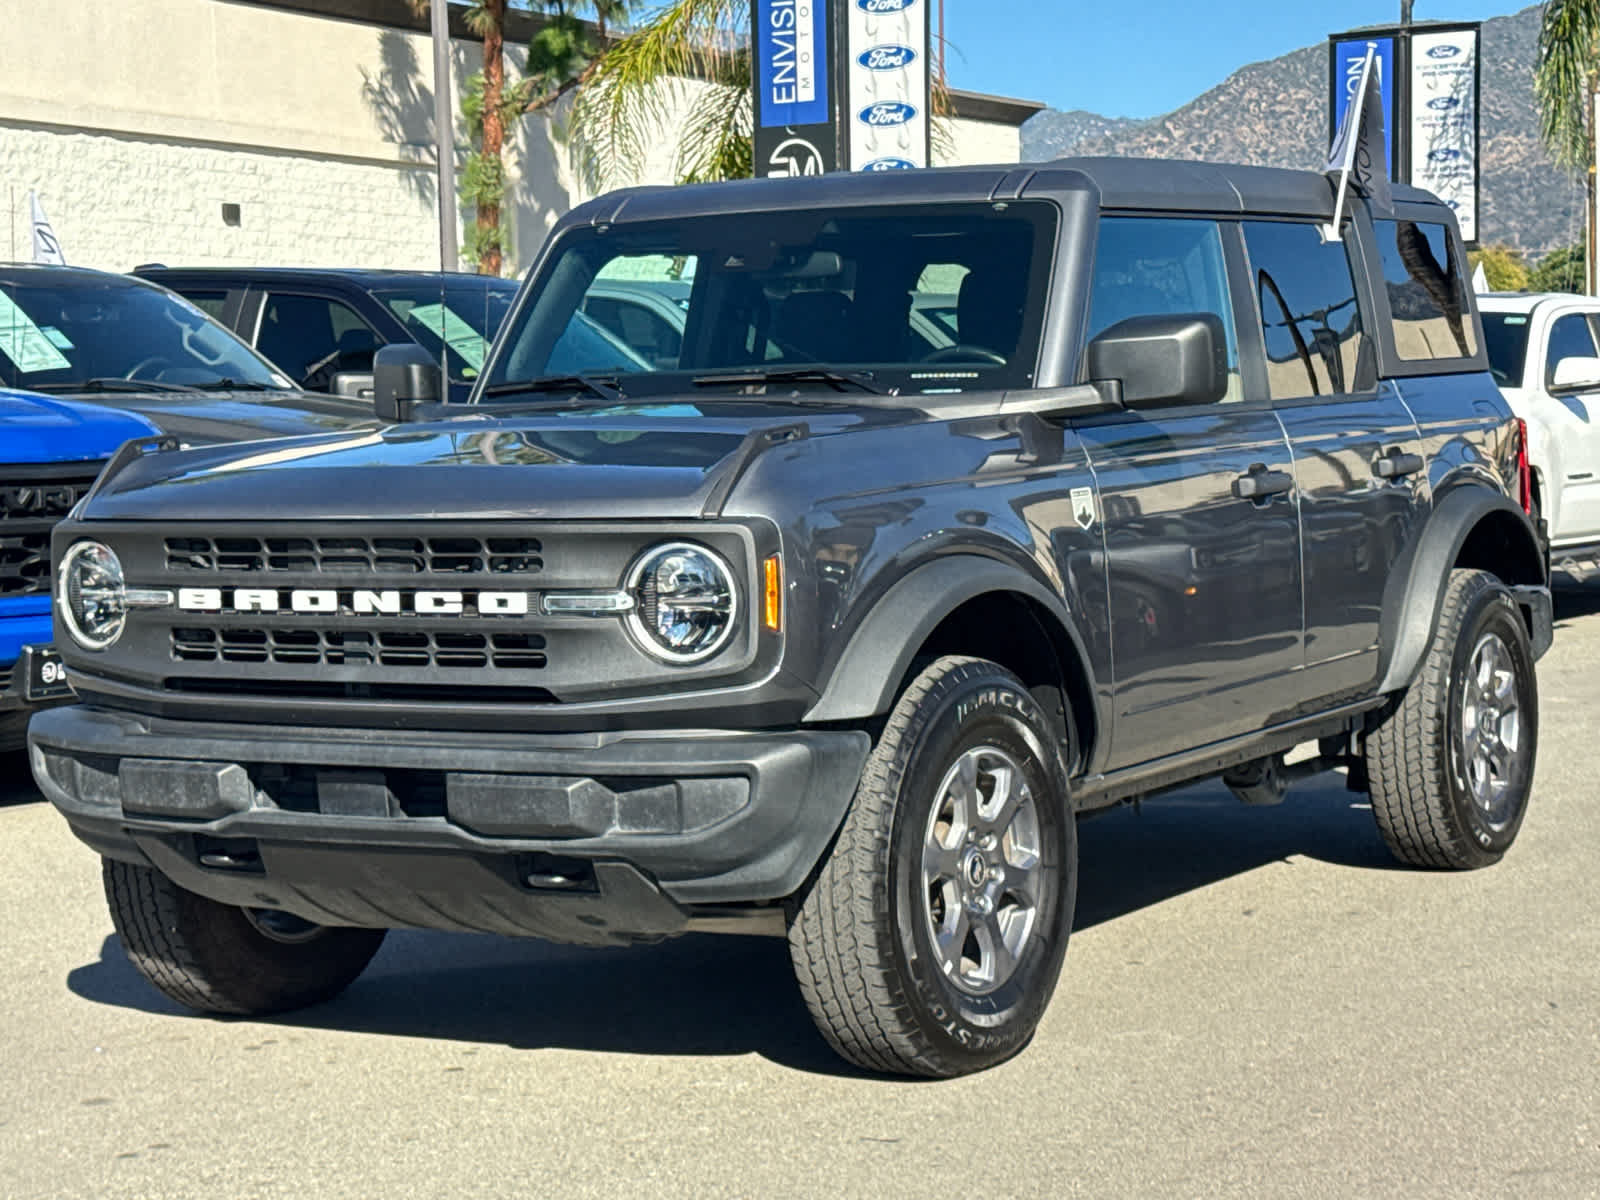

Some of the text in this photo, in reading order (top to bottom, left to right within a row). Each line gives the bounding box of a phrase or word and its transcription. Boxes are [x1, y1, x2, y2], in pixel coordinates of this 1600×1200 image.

[868, 48, 907, 67] Ford
[869, 105, 906, 124] Ford
[178, 588, 528, 614] BRONCO
